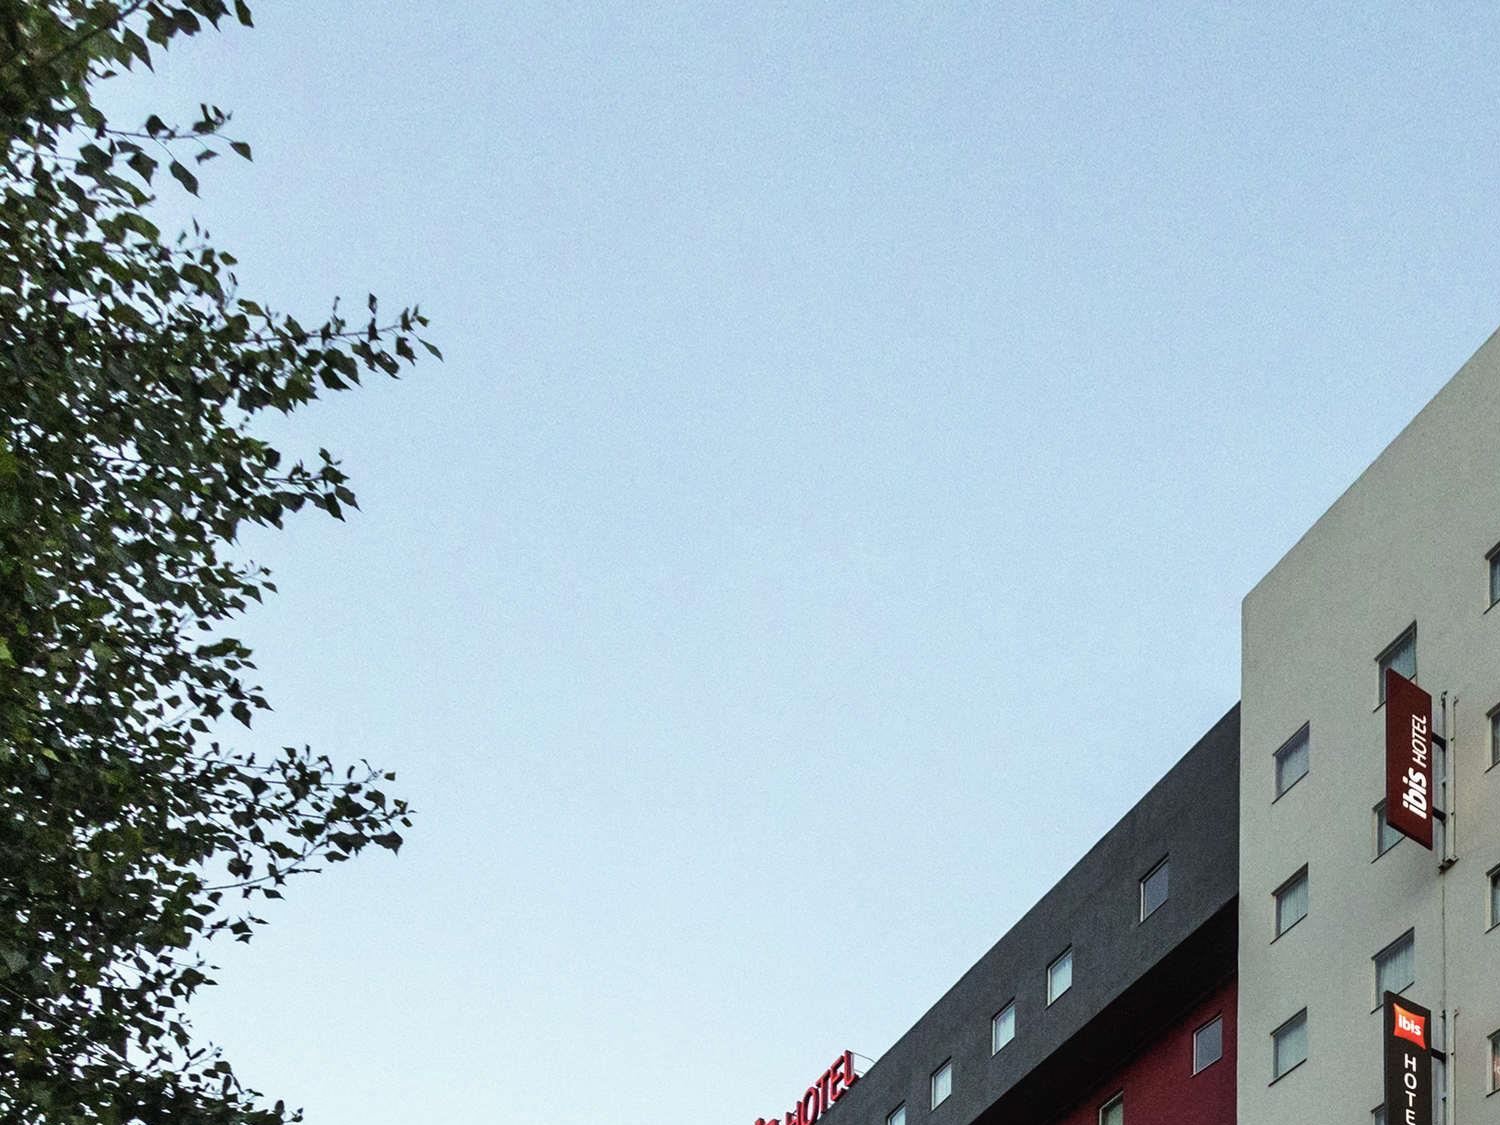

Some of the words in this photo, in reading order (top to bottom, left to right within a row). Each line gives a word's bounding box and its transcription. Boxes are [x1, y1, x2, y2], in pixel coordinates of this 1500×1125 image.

[1411, 714, 1427, 768] HOTEL
[1402, 767, 1427, 819] ibis
[1398, 1014, 1422, 1036] ibis
